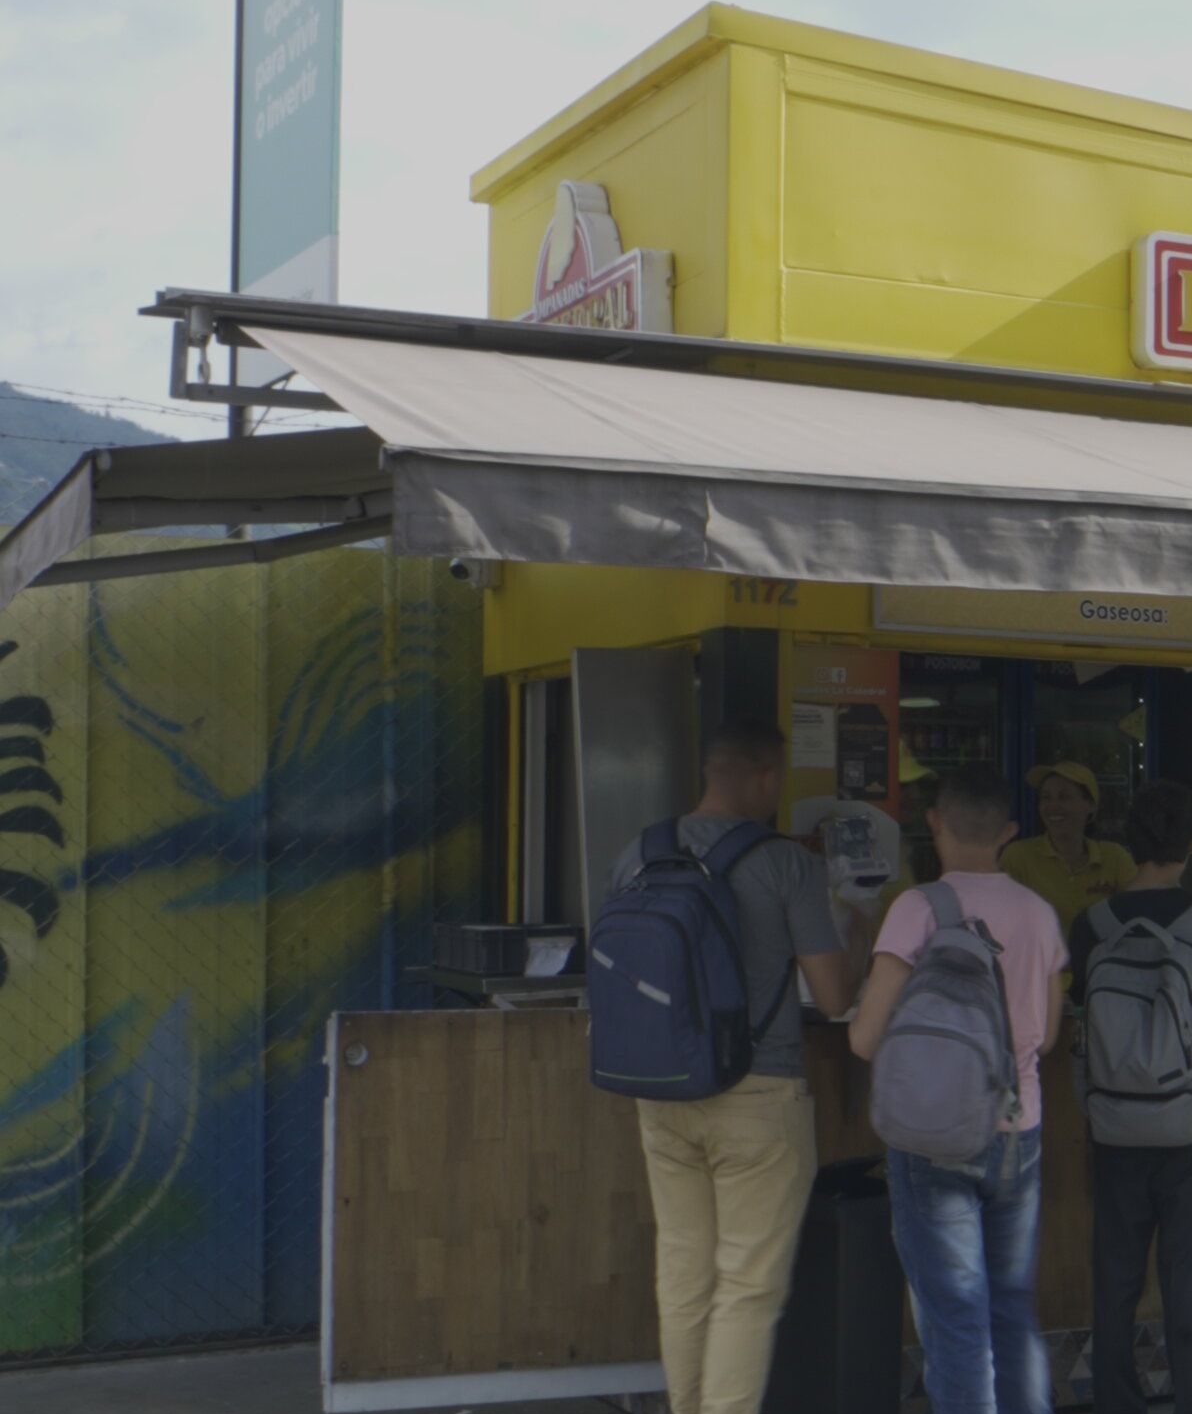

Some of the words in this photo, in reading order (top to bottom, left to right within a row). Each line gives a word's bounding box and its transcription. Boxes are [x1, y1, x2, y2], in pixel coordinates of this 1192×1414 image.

[256, 43, 286, 102] para
[287, 5, 320, 63] vivir
[267, 58, 319, 133] invertir
[1080, 599, 1168, 624] Gaseosa:
